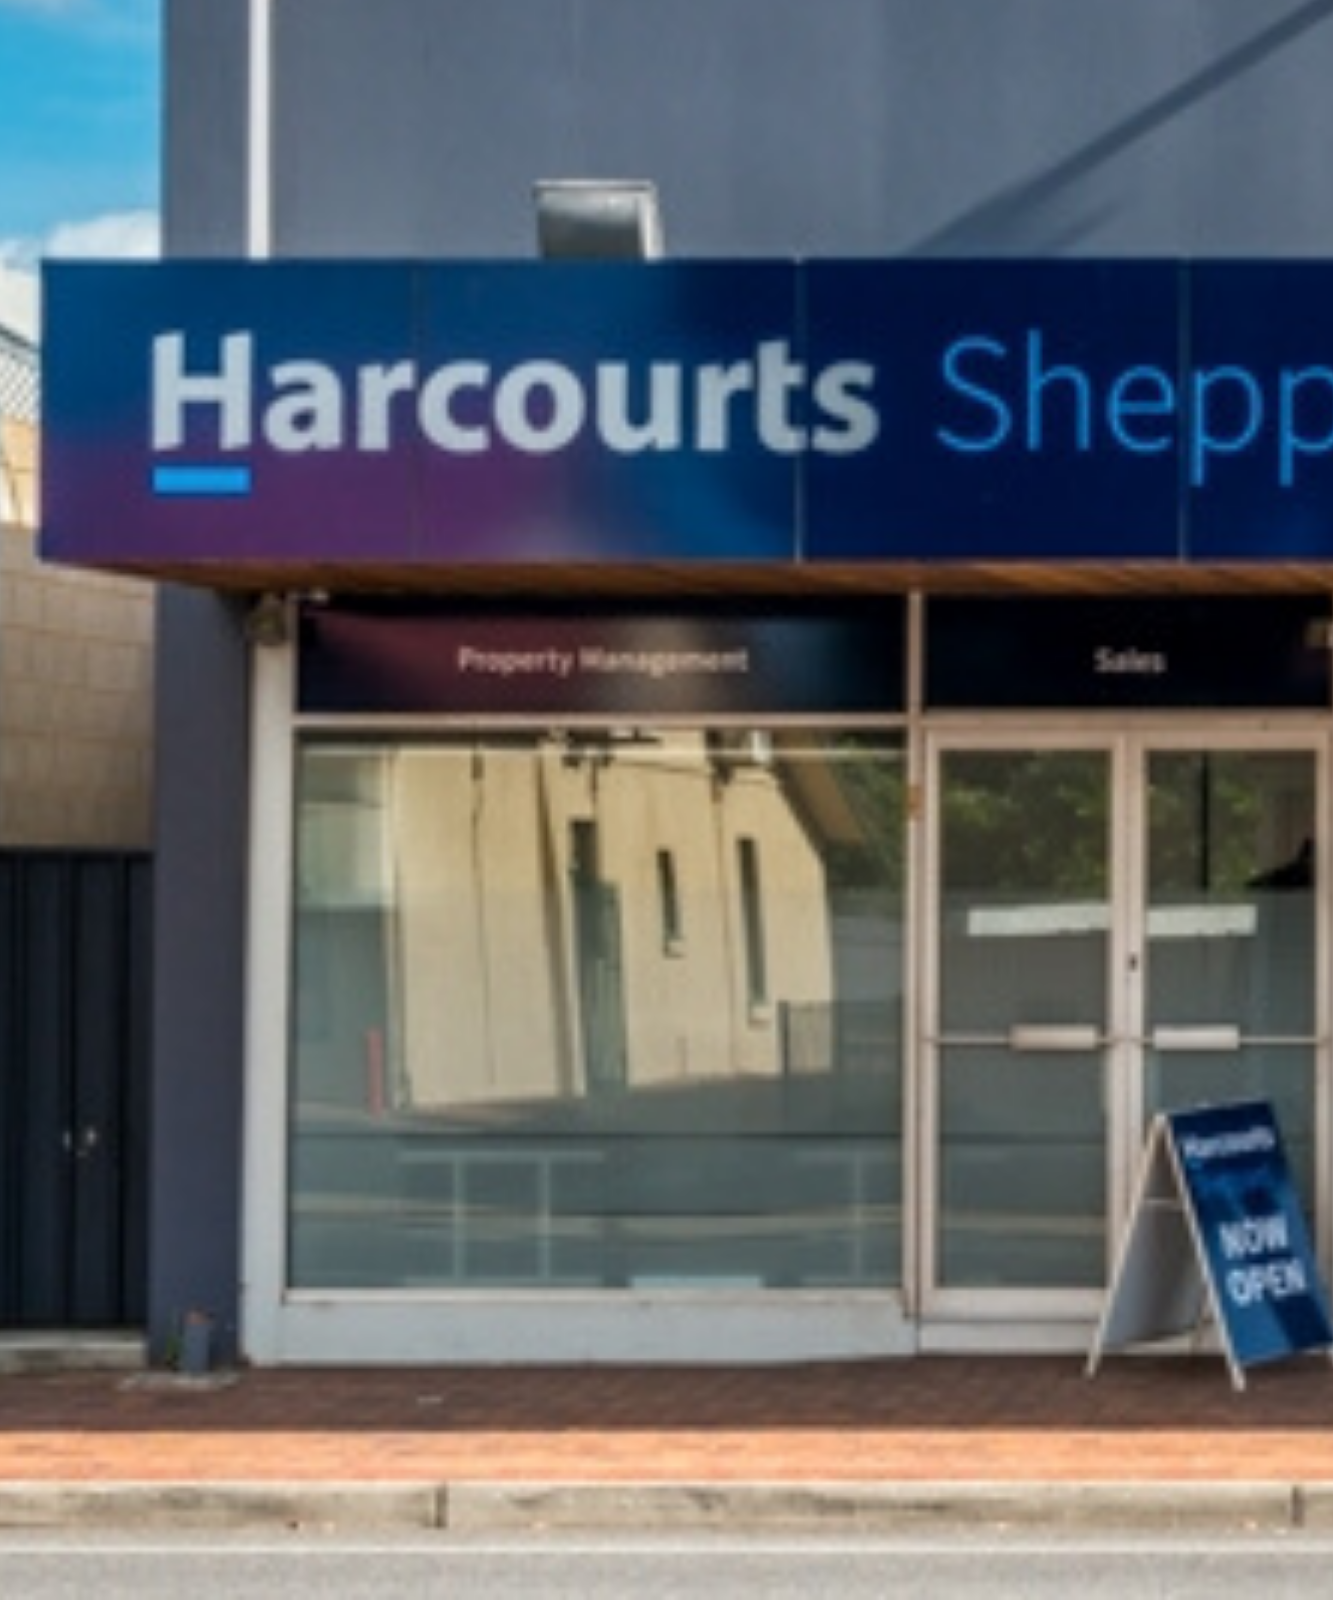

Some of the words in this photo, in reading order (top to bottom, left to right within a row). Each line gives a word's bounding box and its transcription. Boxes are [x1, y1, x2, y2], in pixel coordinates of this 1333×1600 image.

[150, 329, 881, 456] Harcourts
[457, 645, 573, 679] Property
[578, 645, 750, 680] Management
[1093, 647, 1167, 675] Sales
[1217, 1215, 1288, 1261] NOW
[1225, 1257, 1307, 1308] OPEN
